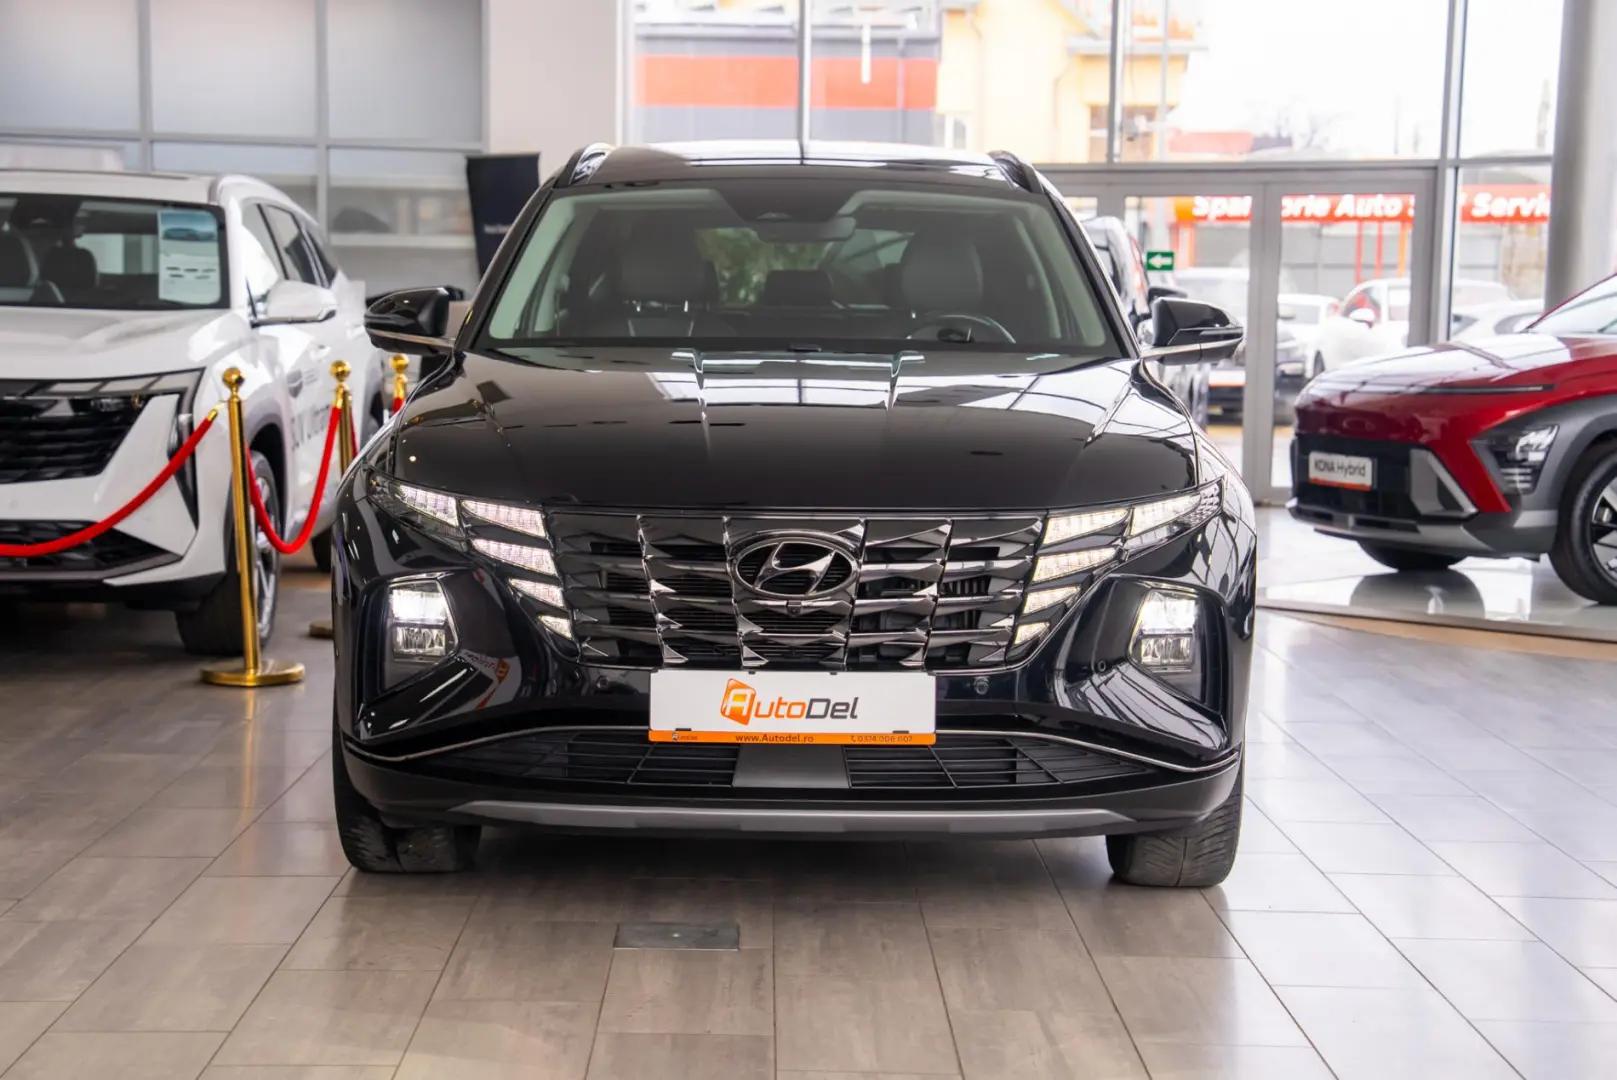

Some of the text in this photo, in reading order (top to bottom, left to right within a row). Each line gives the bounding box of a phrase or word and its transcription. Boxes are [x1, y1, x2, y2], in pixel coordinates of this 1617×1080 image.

[1334, 194, 1403, 217] Auto
[1314, 460, 1366, 477] KONA Hybrid
[722, 685, 859, 720] AutoDel
[735, 733, 814, 743] www.Autodel.ro
